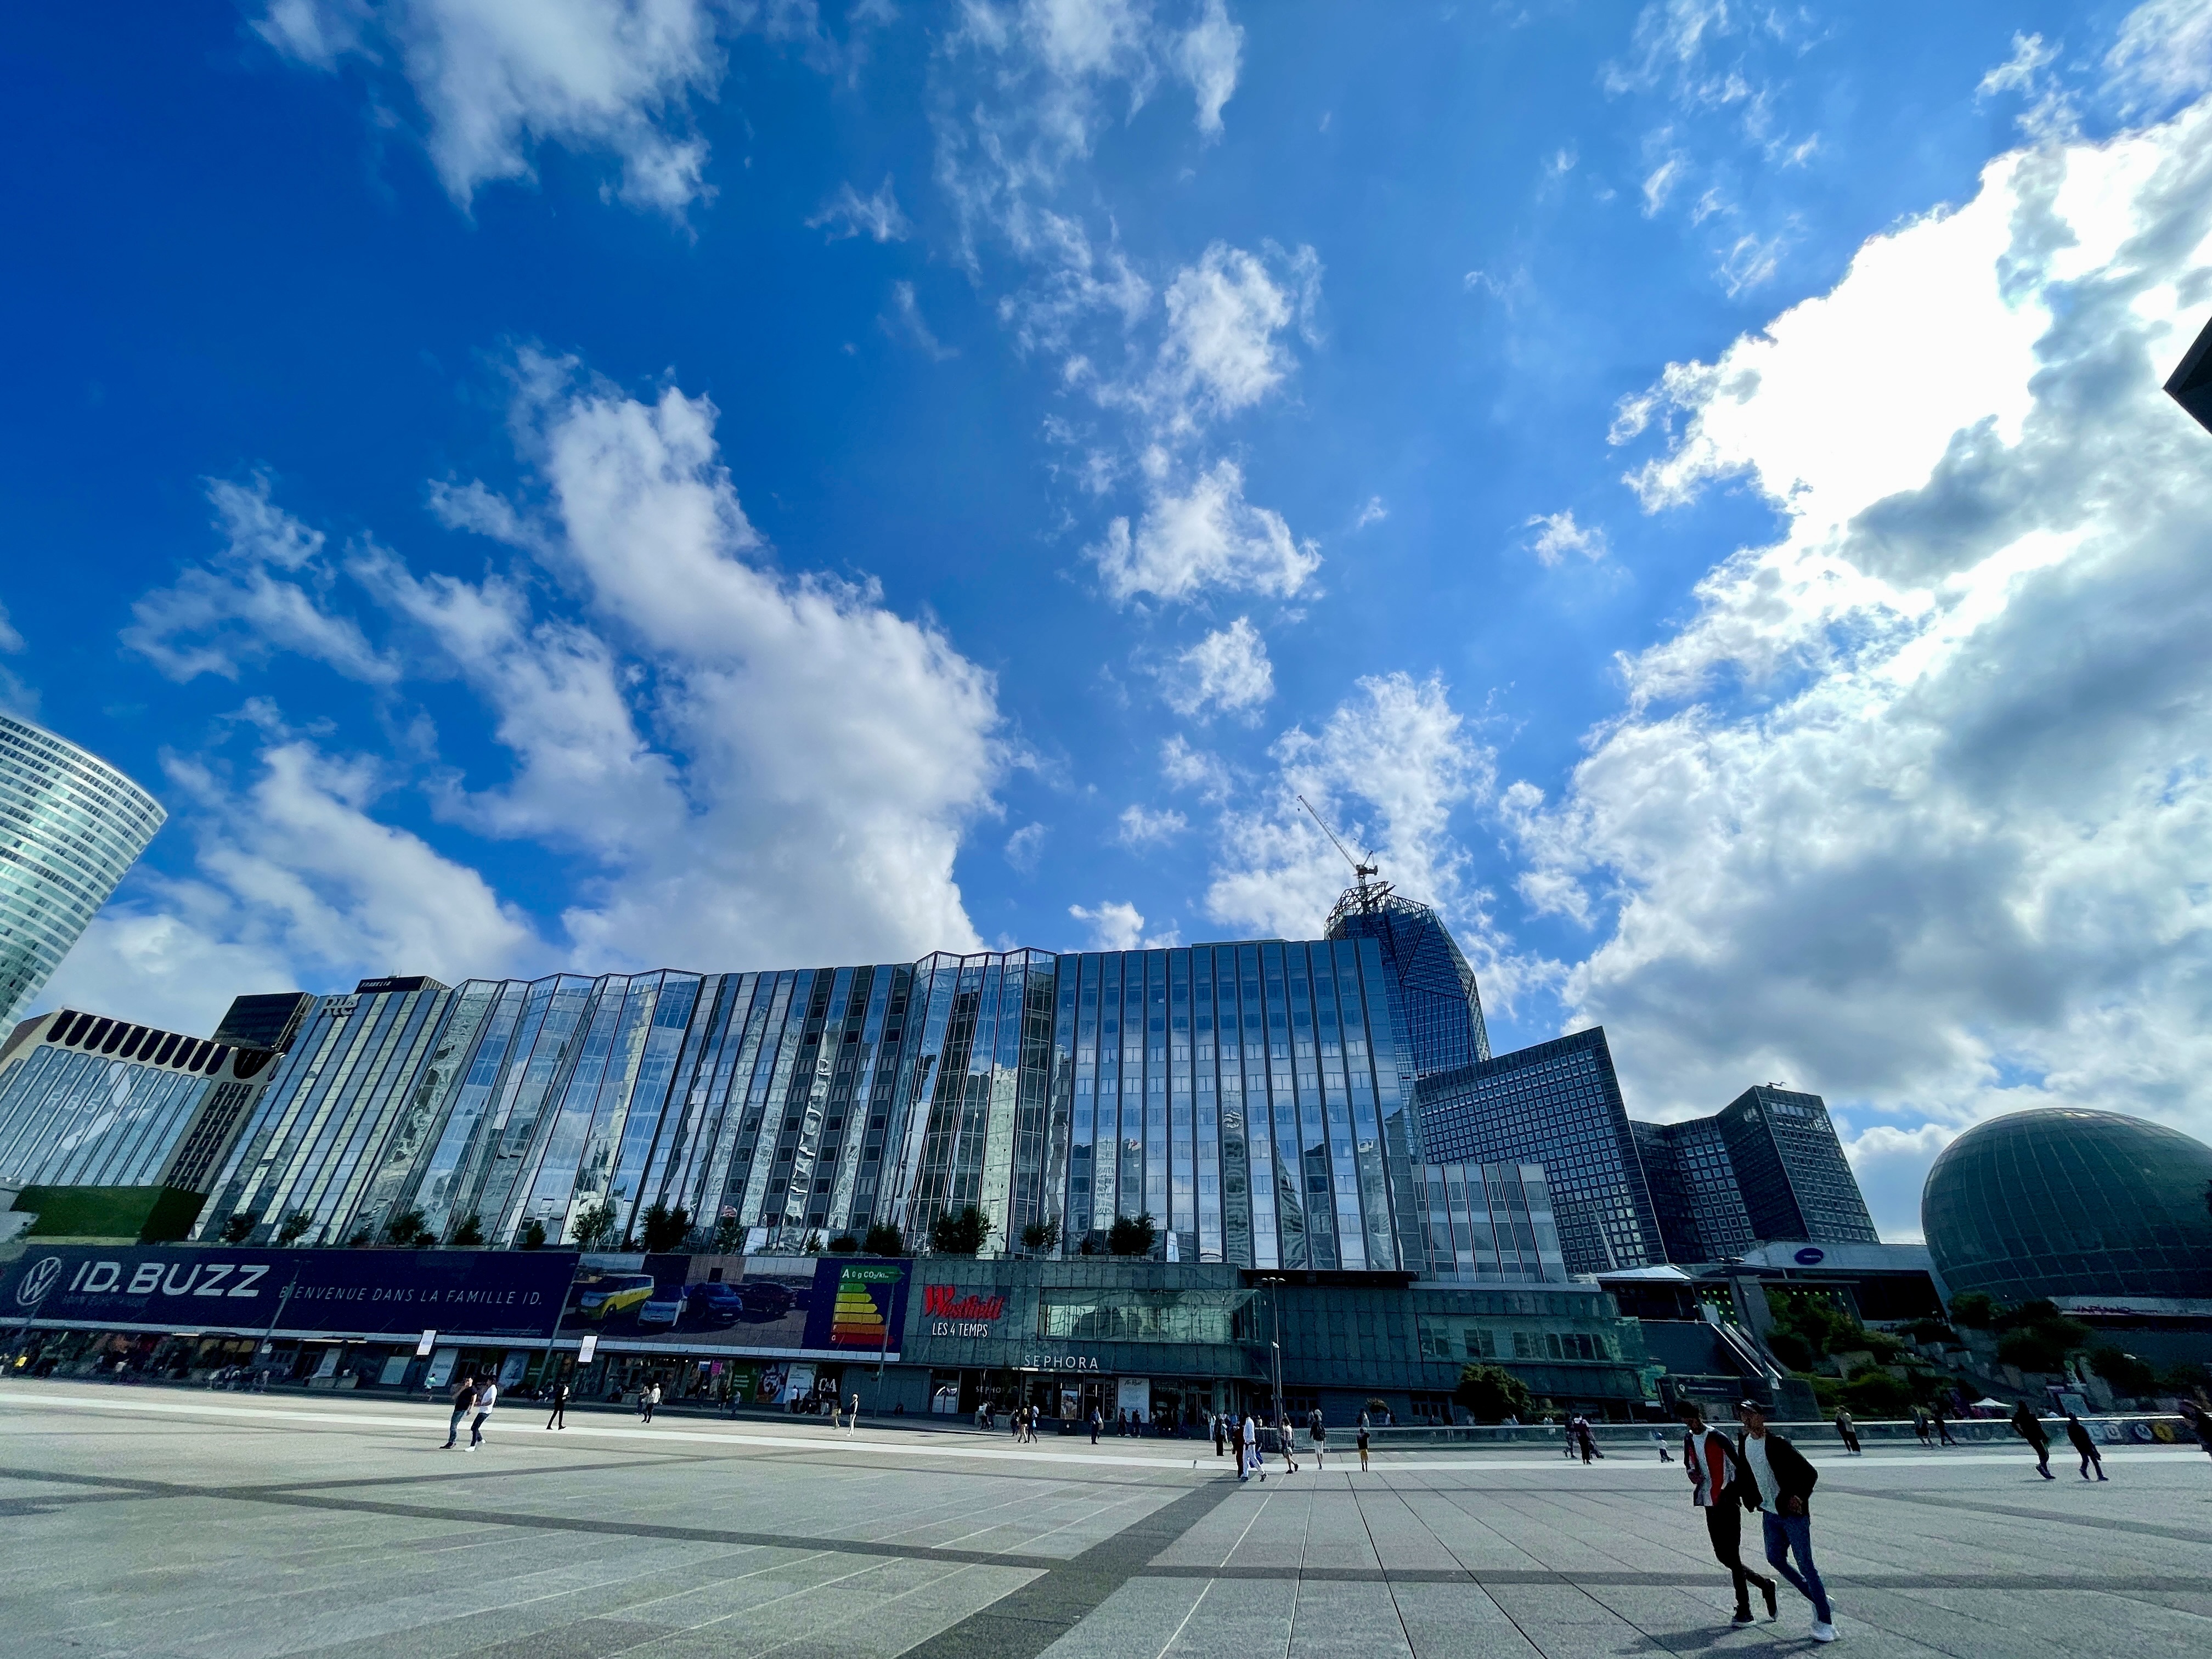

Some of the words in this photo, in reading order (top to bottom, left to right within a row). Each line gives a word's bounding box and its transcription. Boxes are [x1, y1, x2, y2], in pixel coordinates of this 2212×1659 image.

[842, 1269, 850, 1279] A
[279, 1286, 367, 1300] BIENVENUE
[372, 1289, 414, 1302] DANS
[420, 1290, 438, 1302] LA
[445, 1290, 516, 1304] FAMILLE
[522, 1292, 542, 1305] ID.
[924, 1285, 1005, 1321] Westfield
[932, 1322, 948, 1336] LES
[950, 1323, 955, 1336] 4
[959, 1323, 989, 1338] TEMPS
[1024, 1355, 1098, 1369] SEPHORA
